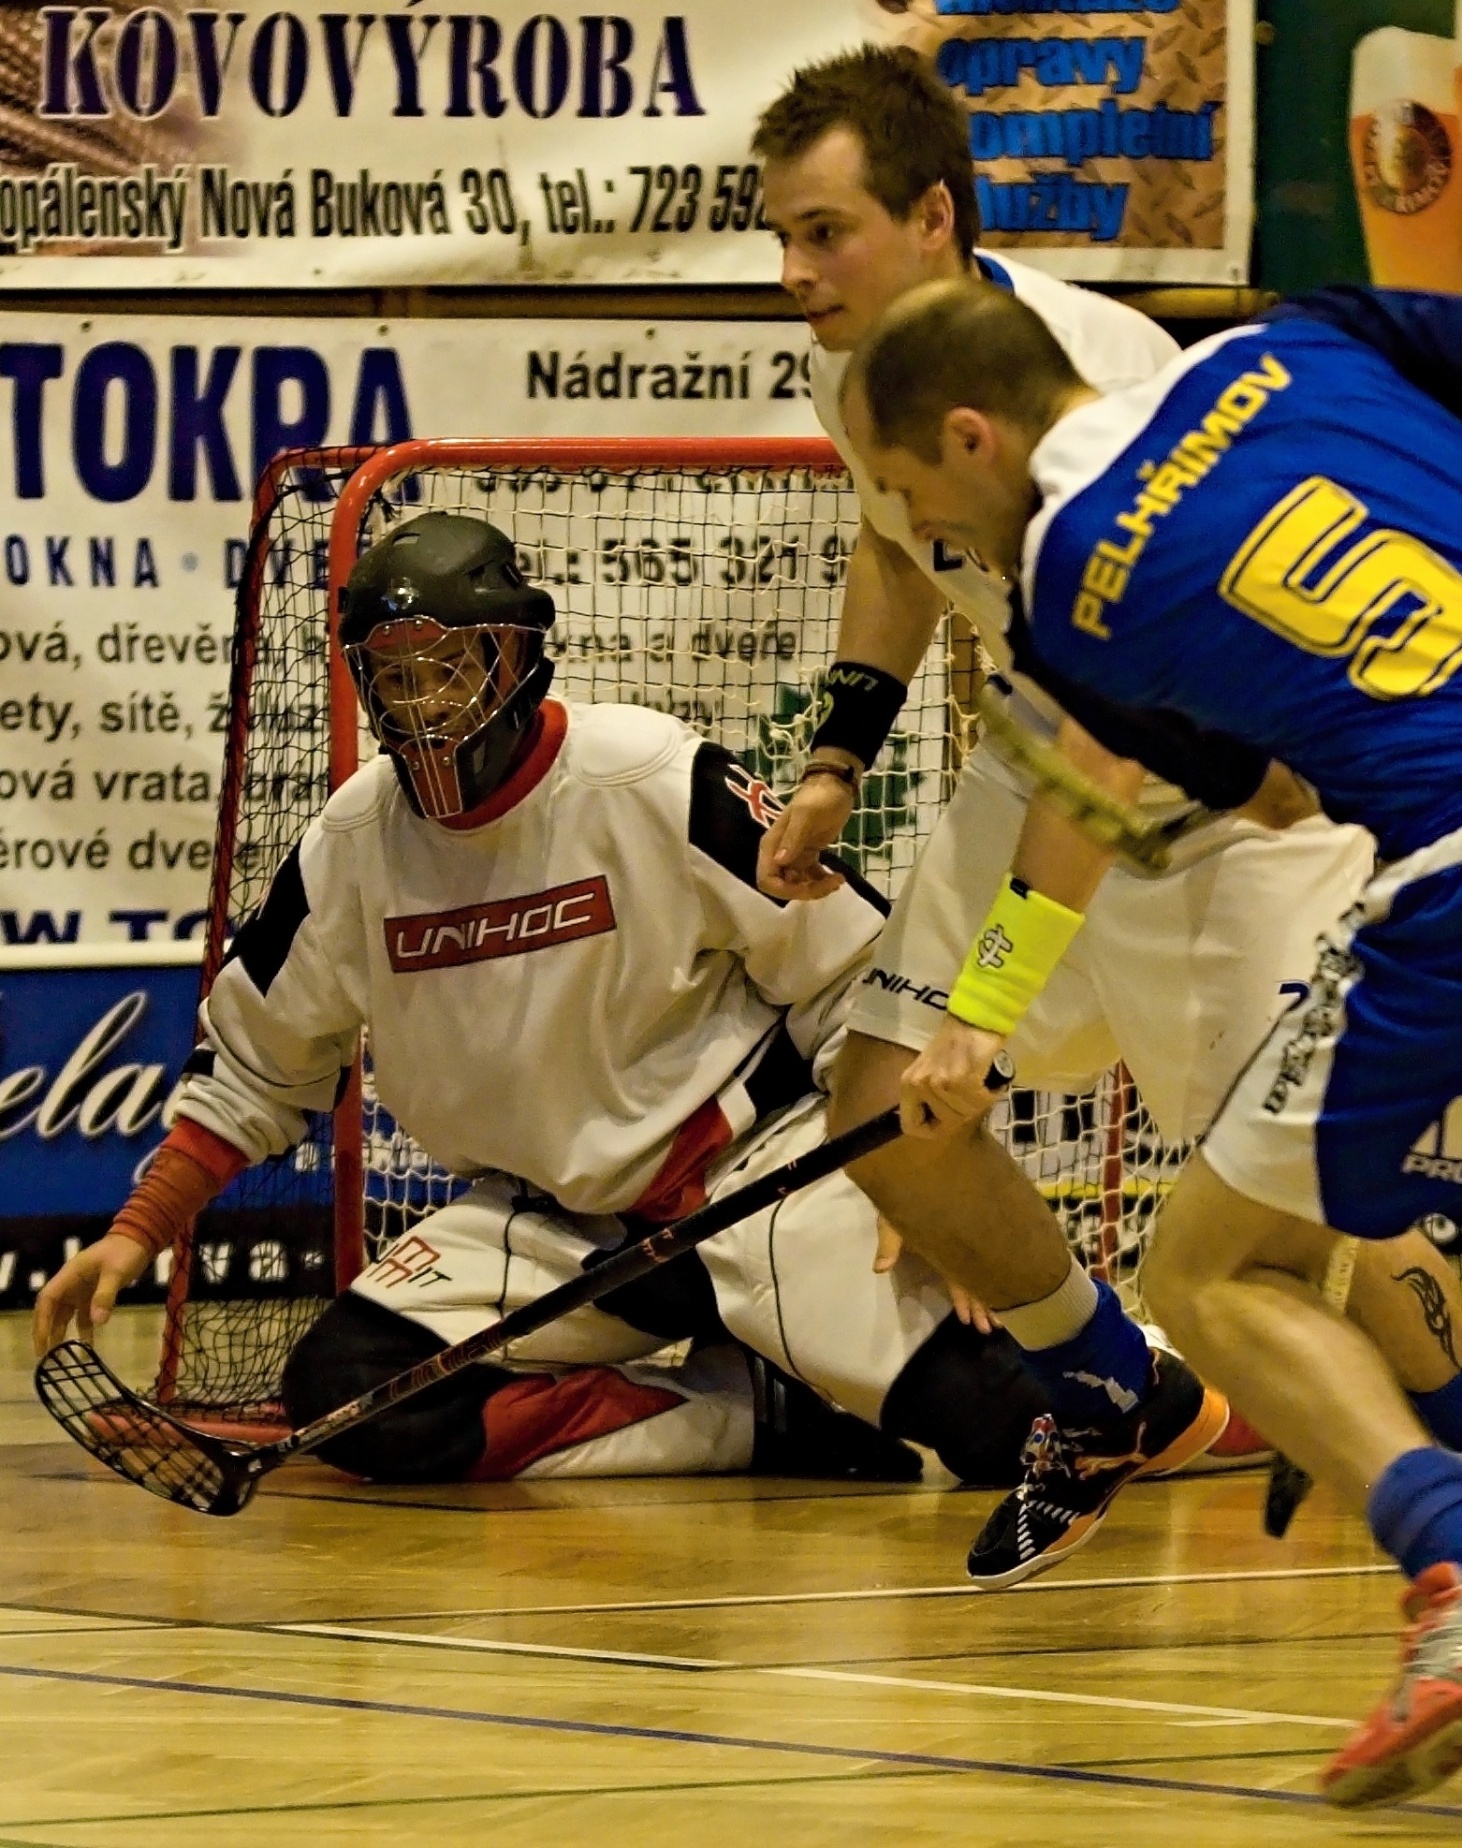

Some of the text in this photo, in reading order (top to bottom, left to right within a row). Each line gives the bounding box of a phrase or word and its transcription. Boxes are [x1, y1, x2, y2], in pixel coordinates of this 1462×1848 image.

[39, 0, 706, 120] KOVOVÝROBA
[969, 99, 1224, 167] ompletní
[201, 167, 295, 238] Nová
[311, 168, 452, 237] Buková
[461, 167, 531, 246] 30,
[539, 167, 616, 234] tel.:
[627, 164, 702, 233] 723
[974, 172, 1130, 241] lužby
[527, 350, 750, 399] Nádražní
[1070, 352, 1292, 641] PELHŘIMOV
[3, 535, 372, 592] OKNA DVE
[602, 536, 697, 586] 565
[719, 535, 801, 584] 321
[692, 624, 798, 663] dveře
[100, 690, 194, 740] sítě,
[396, 892, 596, 958] UNIHOC
[862, 967, 950, 1011] NIHO
